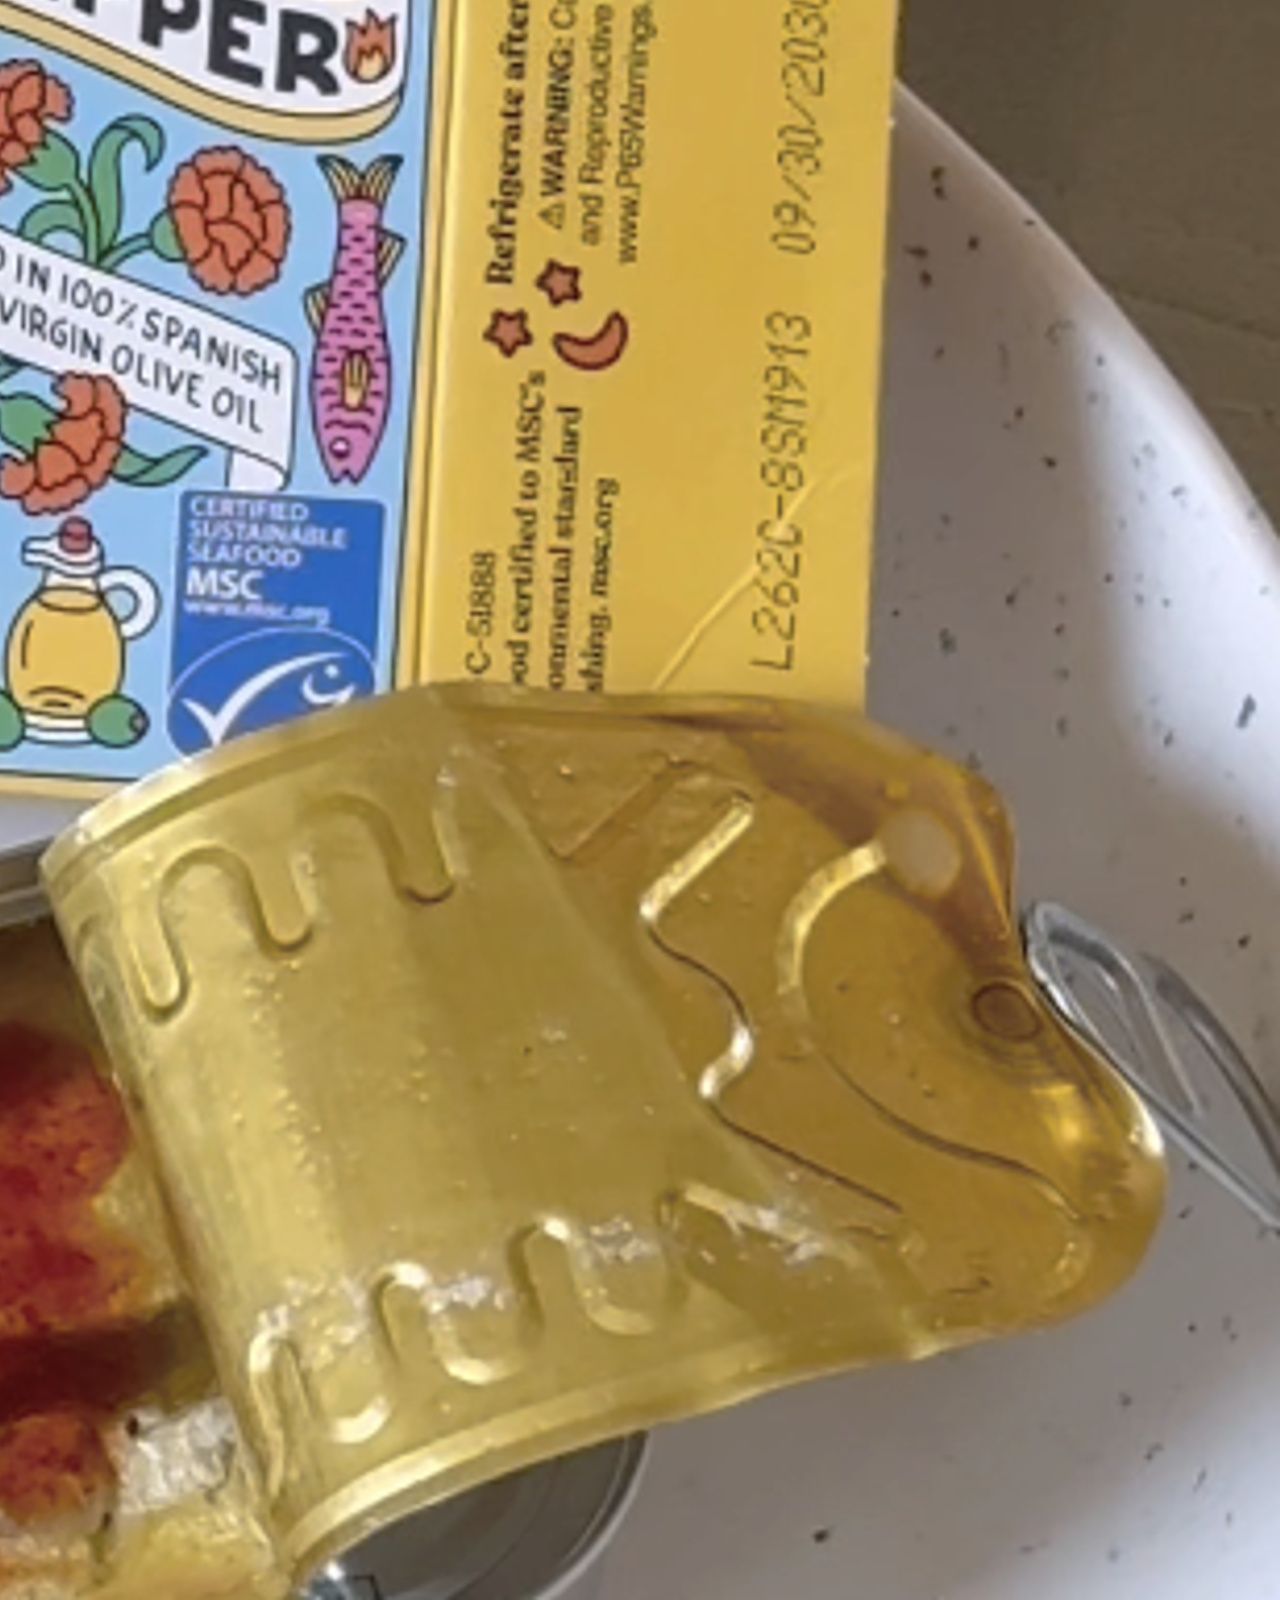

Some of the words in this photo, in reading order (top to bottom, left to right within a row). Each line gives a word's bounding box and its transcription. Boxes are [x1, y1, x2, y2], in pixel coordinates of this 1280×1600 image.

[540, 36, 576, 199] WARNING:
[579, 4, 613, 185] Reproductive
[486, 82, 525, 285] Refrigerate
[579, 188, 602, 247] and
[13, 254, 52, 294] IN
[57, 268, 138, 330] 100%
[143, 307, 284, 396] SPANISH
[111, 343, 203, 407] OLIVE
[211, 388, 264, 435] OIL
[190, 495, 310, 521] CERTIFIED
[519, 469, 540, 502] to
[553, 406, 582, 539] standard
[187, 542, 302, 568] SEAFOOD
[188, 518, 349, 551] SUSTAINABLE
[508, 507, 537, 634] certified
[186, 567, 265, 601] MSC
